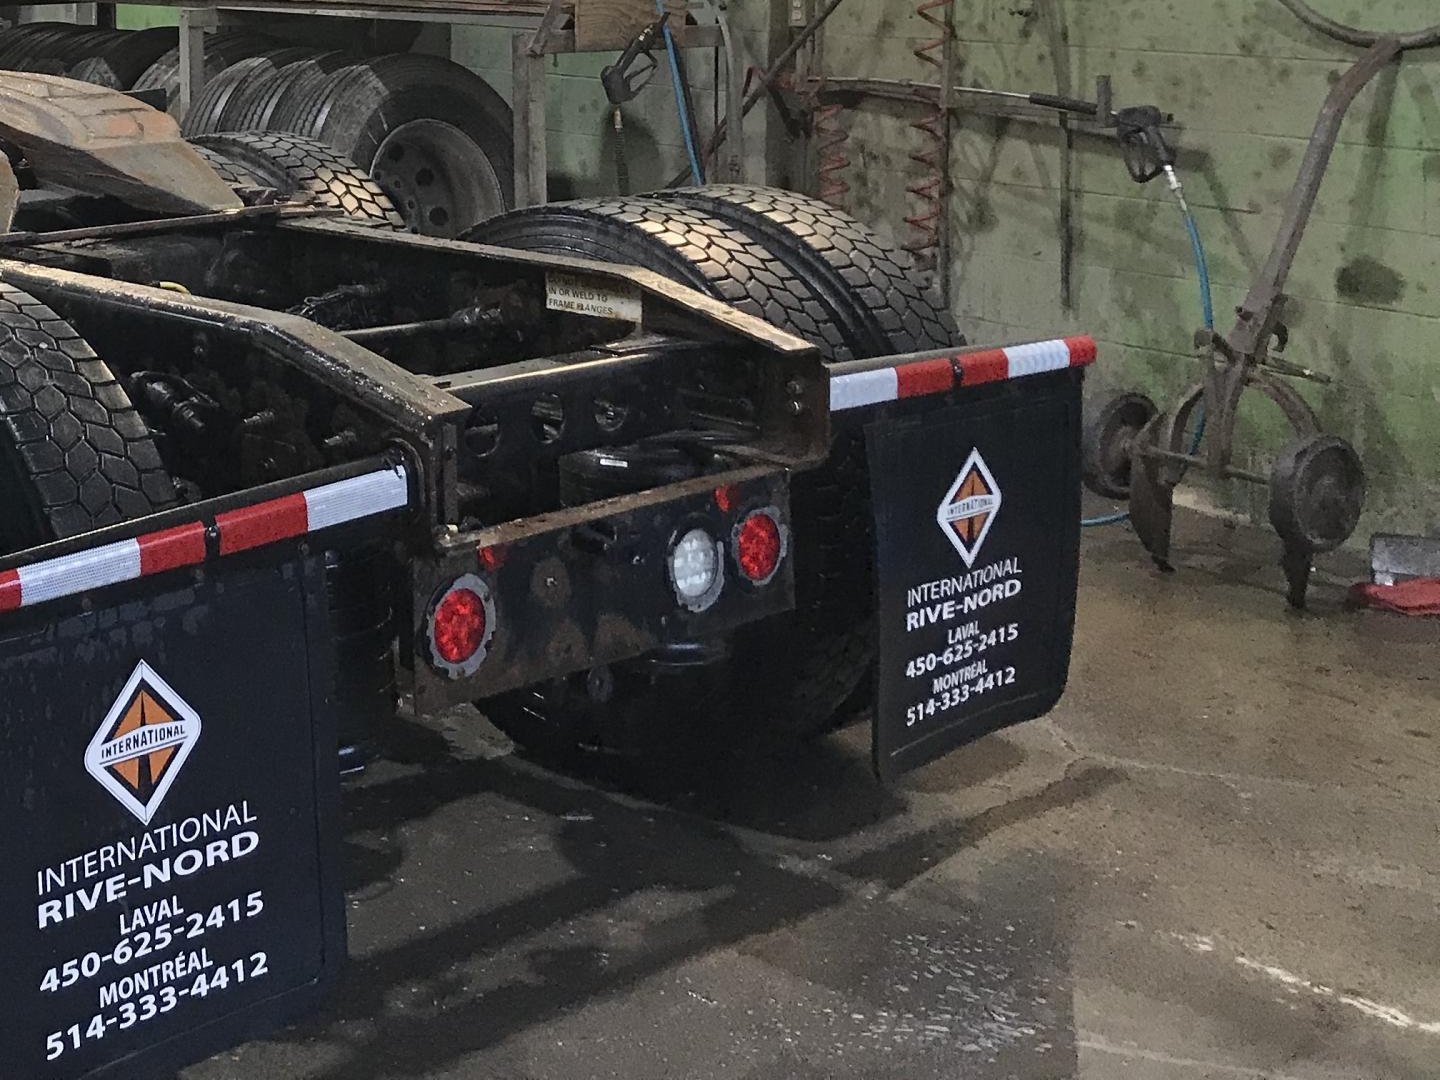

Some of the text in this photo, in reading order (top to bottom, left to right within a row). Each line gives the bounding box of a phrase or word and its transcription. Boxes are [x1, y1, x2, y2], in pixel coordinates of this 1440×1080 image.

[548, 298, 574, 309] FRAME
[572, 290, 595, 300] WELD
[597, 294, 608, 303] TO
[907, 557, 1022, 608] INTERNATIONAL
[907, 579, 1022, 631] RIVE-NORD
[905, 623, 1019, 678] 450-625-2415
[948, 621, 980, 644] LAVAL
[906, 666, 1016, 727] 514-333-4412
[101, 724, 185, 758] INTERNATIONAL
[37, 800, 258, 896] INTERNATIONAL
[38, 831, 260, 929] RIVE-NORD
[119, 895, 184, 935] LAVAL
[39, 891, 264, 993] 450-625-2415
[99, 947, 213, 1008] MONTRÉAL
[46, 952, 268, 1061] 514-333-4412
